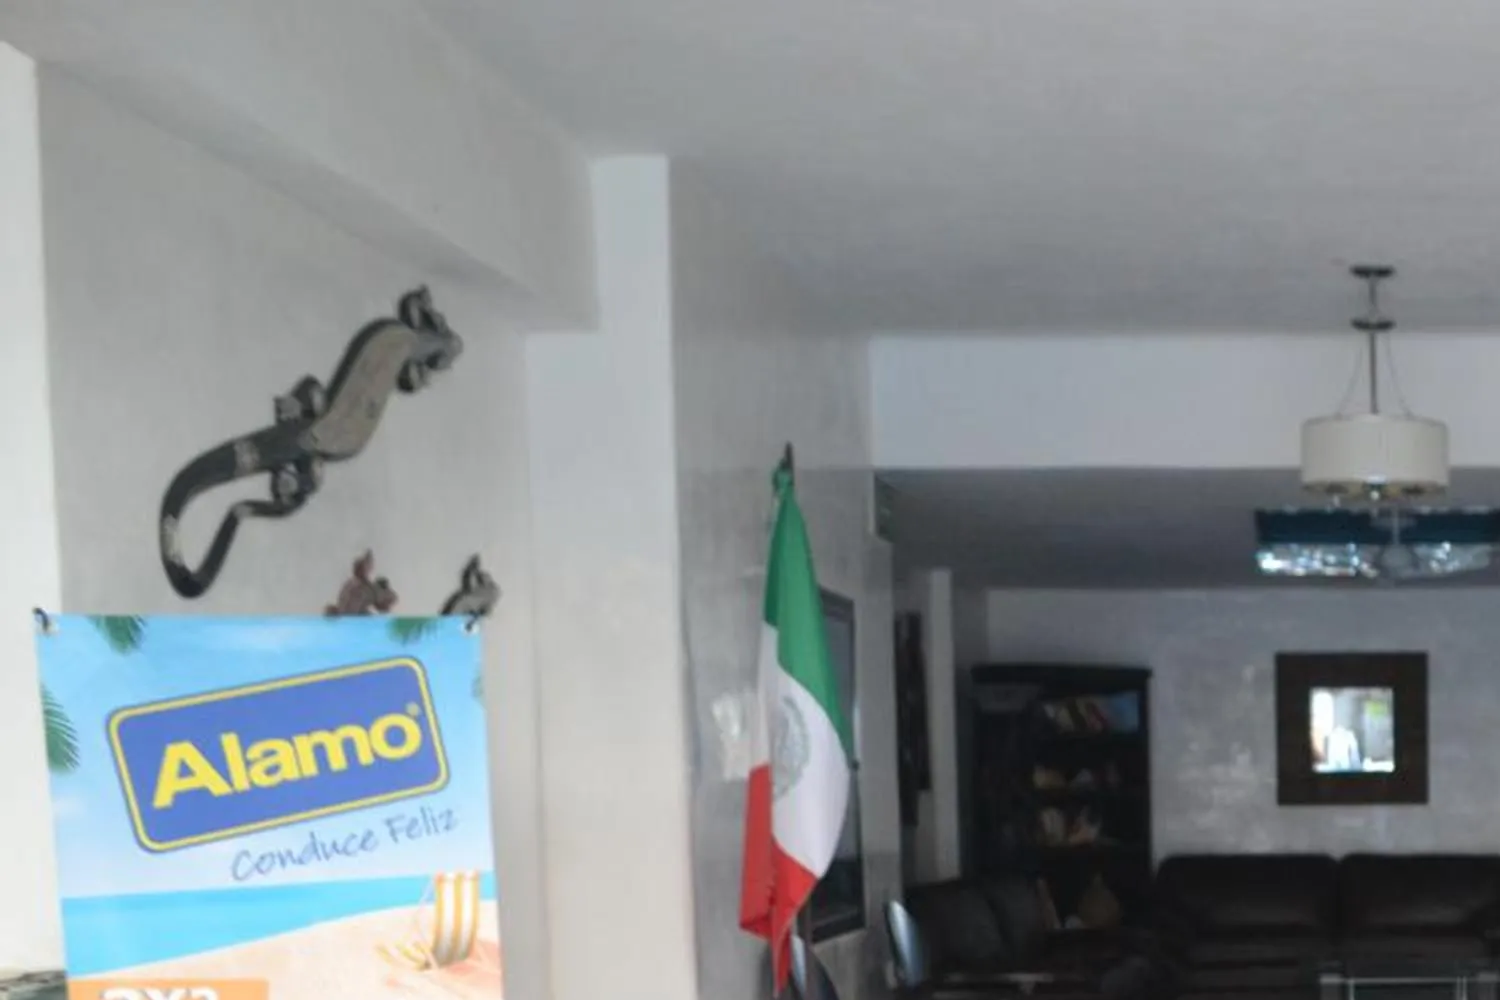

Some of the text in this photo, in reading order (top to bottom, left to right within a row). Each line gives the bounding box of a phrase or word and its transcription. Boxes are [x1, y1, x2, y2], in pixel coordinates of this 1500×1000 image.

[153, 713, 422, 809] Alamo
[230, 806, 458, 882] Conduce Feliz
